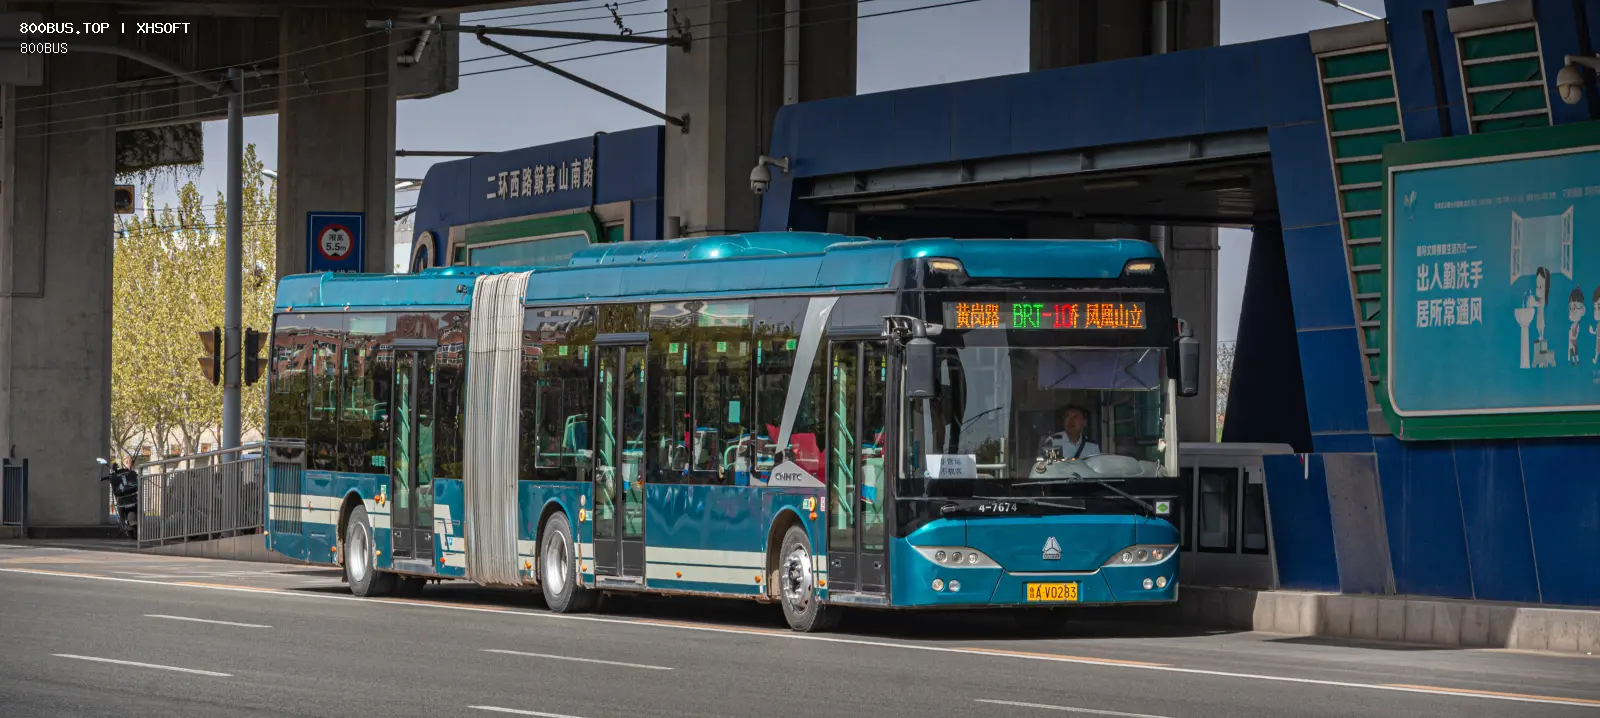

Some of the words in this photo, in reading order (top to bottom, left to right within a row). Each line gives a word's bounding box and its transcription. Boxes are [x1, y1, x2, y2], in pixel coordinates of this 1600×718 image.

[328, 233, 344, 242] 限高
[956, 303, 1000, 329] 黄岗路
[1416, 296, 1483, 328] 居所常通风
[775, 472, 803, 482] CNHTC
[978, 501, 1018, 513] 4-7674
